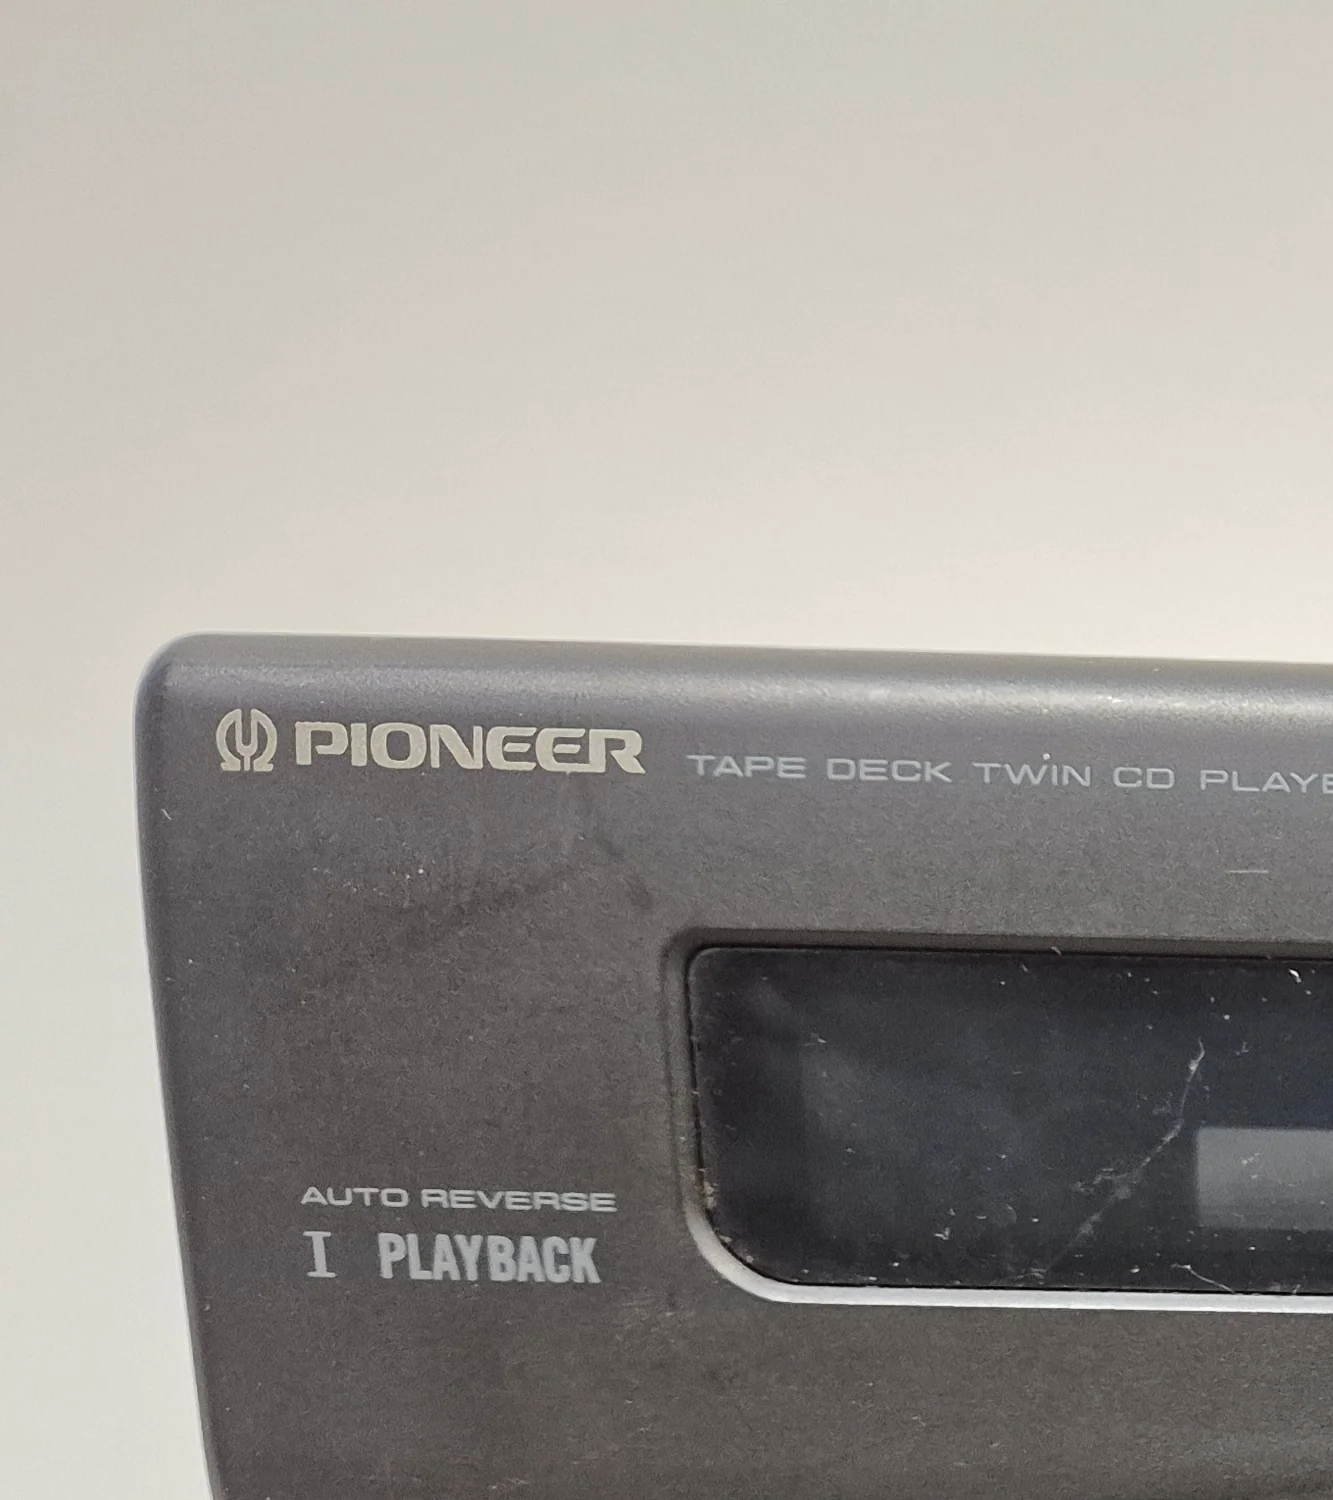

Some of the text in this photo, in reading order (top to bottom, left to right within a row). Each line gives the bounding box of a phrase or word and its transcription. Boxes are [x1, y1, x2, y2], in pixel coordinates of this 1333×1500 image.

[295, 720, 646, 774] PIONEER
[687, 754, 806, 780] TAPE
[827, 757, 952, 783] DECK
[973, 761, 1091, 788] TWIN
[1113, 766, 1175, 790] CD
[301, 1187, 617, 1213] AUTO REVERSE
[380, 1233, 601, 1284] PLAYBACK
